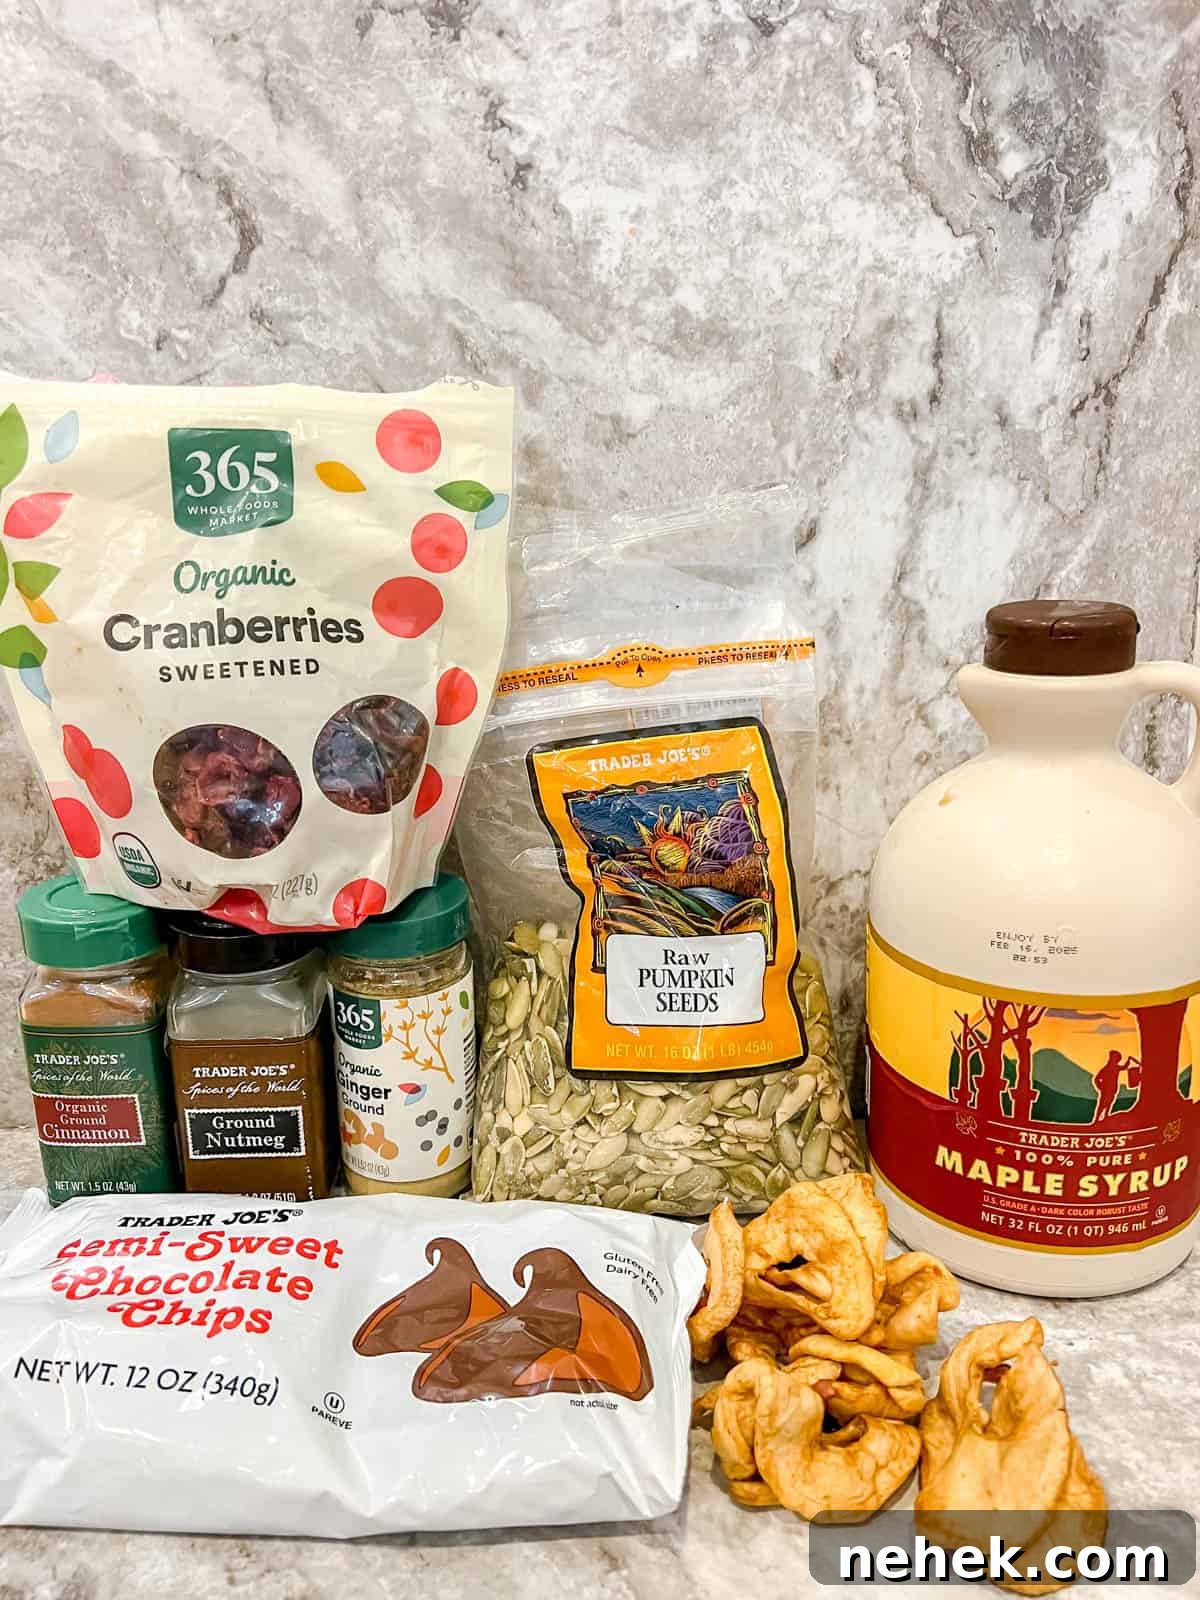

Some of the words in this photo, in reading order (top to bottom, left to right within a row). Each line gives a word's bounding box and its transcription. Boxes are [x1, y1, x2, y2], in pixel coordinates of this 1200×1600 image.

[185, 445, 279, 497] 365
[187, 505, 232, 515] WHOLE
[209, 512, 258, 527] MARKET
[174, 559, 296, 599] Organic
[103, 608, 364, 651] Cranberries
[698, 655, 728, 665] PRESS
[731, 652, 743, 662] TO
[159, 658, 320, 683] SWEETENED
[496, 681, 521, 693] ESS
[523, 678, 536, 689] TO
[538, 672, 578, 686] RESEAL
[587, 753, 652, 773] TRADER
[118, 845, 144, 862] USDA
[281, 872, 318, 900] (227g)
[990, 939, 1009, 950] FEB
[996, 931, 1032, 942] ENJOY
[1043, 935, 1059, 943] BY
[663, 949, 710, 966] Raw
[638, 967, 734, 989] PUMPKIN
[656, 992, 719, 1012] SEEDS
[337, 1001, 375, 1032] 365
[33, 1054, 81, 1065] TRADER
[83, 1054, 119, 1065] JOE'S
[606, 1044, 632, 1057] NET
[665, 1045, 680, 1058] 16
[99, 1068, 136, 1081] World
[192, 1066, 248, 1078] TRADER
[250, 1065, 289, 1077] JOE'S
[338, 1052, 383, 1078] Organic
[182, 1082, 224, 1100] Spices
[266, 1078, 305, 1093] World
[336, 1070, 392, 1101] Ginger
[55, 1100, 108, 1114] Organic
[342, 1094, 385, 1117] Ground
[60, 1114, 107, 1126] Ground
[212, 1115, 276, 1130] Ground
[42, 1123, 130, 1140] Cinnamon
[205, 1132, 286, 1150] Nutmeg
[1019, 1132, 1080, 1148] TRADER
[1084, 1135, 1127, 1149] JOE'S
[1014, 1150, 1074, 1167] 100%
[1086, 1154, 1133, 1168] PURE
[935, 1144, 1065, 1197] MAPLE
[1076, 1154, 1189, 1199] SYRUP
[55, 1180, 70, 1191] NET
[89, 1181, 101, 1192] 1.5
[103, 1181, 114, 1192] OZ
[274, 1191, 296, 1203] (51G)
[1000, 1199, 1029, 1212] GRADE
[1067, 1208, 1095, 1217] COLOR
[117, 1213, 216, 1227] TRADER
[981, 1211, 1005, 1226] NET
[1008, 1217, 1025, 1230] 32
[1028, 1221, 1042, 1234] FL
[1046, 1223, 1064, 1236] OZ
[1067, 1225, 1079, 1238] (1
[1083, 1224, 1105, 1238] QT)
[1107, 1223, 1129, 1235] 946
[57, 1230, 344, 1269] Semi-Sweet
[603, 1252, 645, 1274] Gluten
[51, 1260, 314, 1301] Chocolate
[606, 1264, 640, 1279] Dairy
[641, 1278, 658, 1304] Free
[107, 1298, 273, 1339] Chips
[14, 1356, 71, 1385] NET
[73, 1360, 118, 1387] WT.
[125, 1365, 151, 1389] 12
[156, 1368, 198, 1393] OZ
[200, 1370, 280, 1406] (340g)
[569, 1399, 585, 1407] not
[311, 1405, 353, 1430] PAREVE
